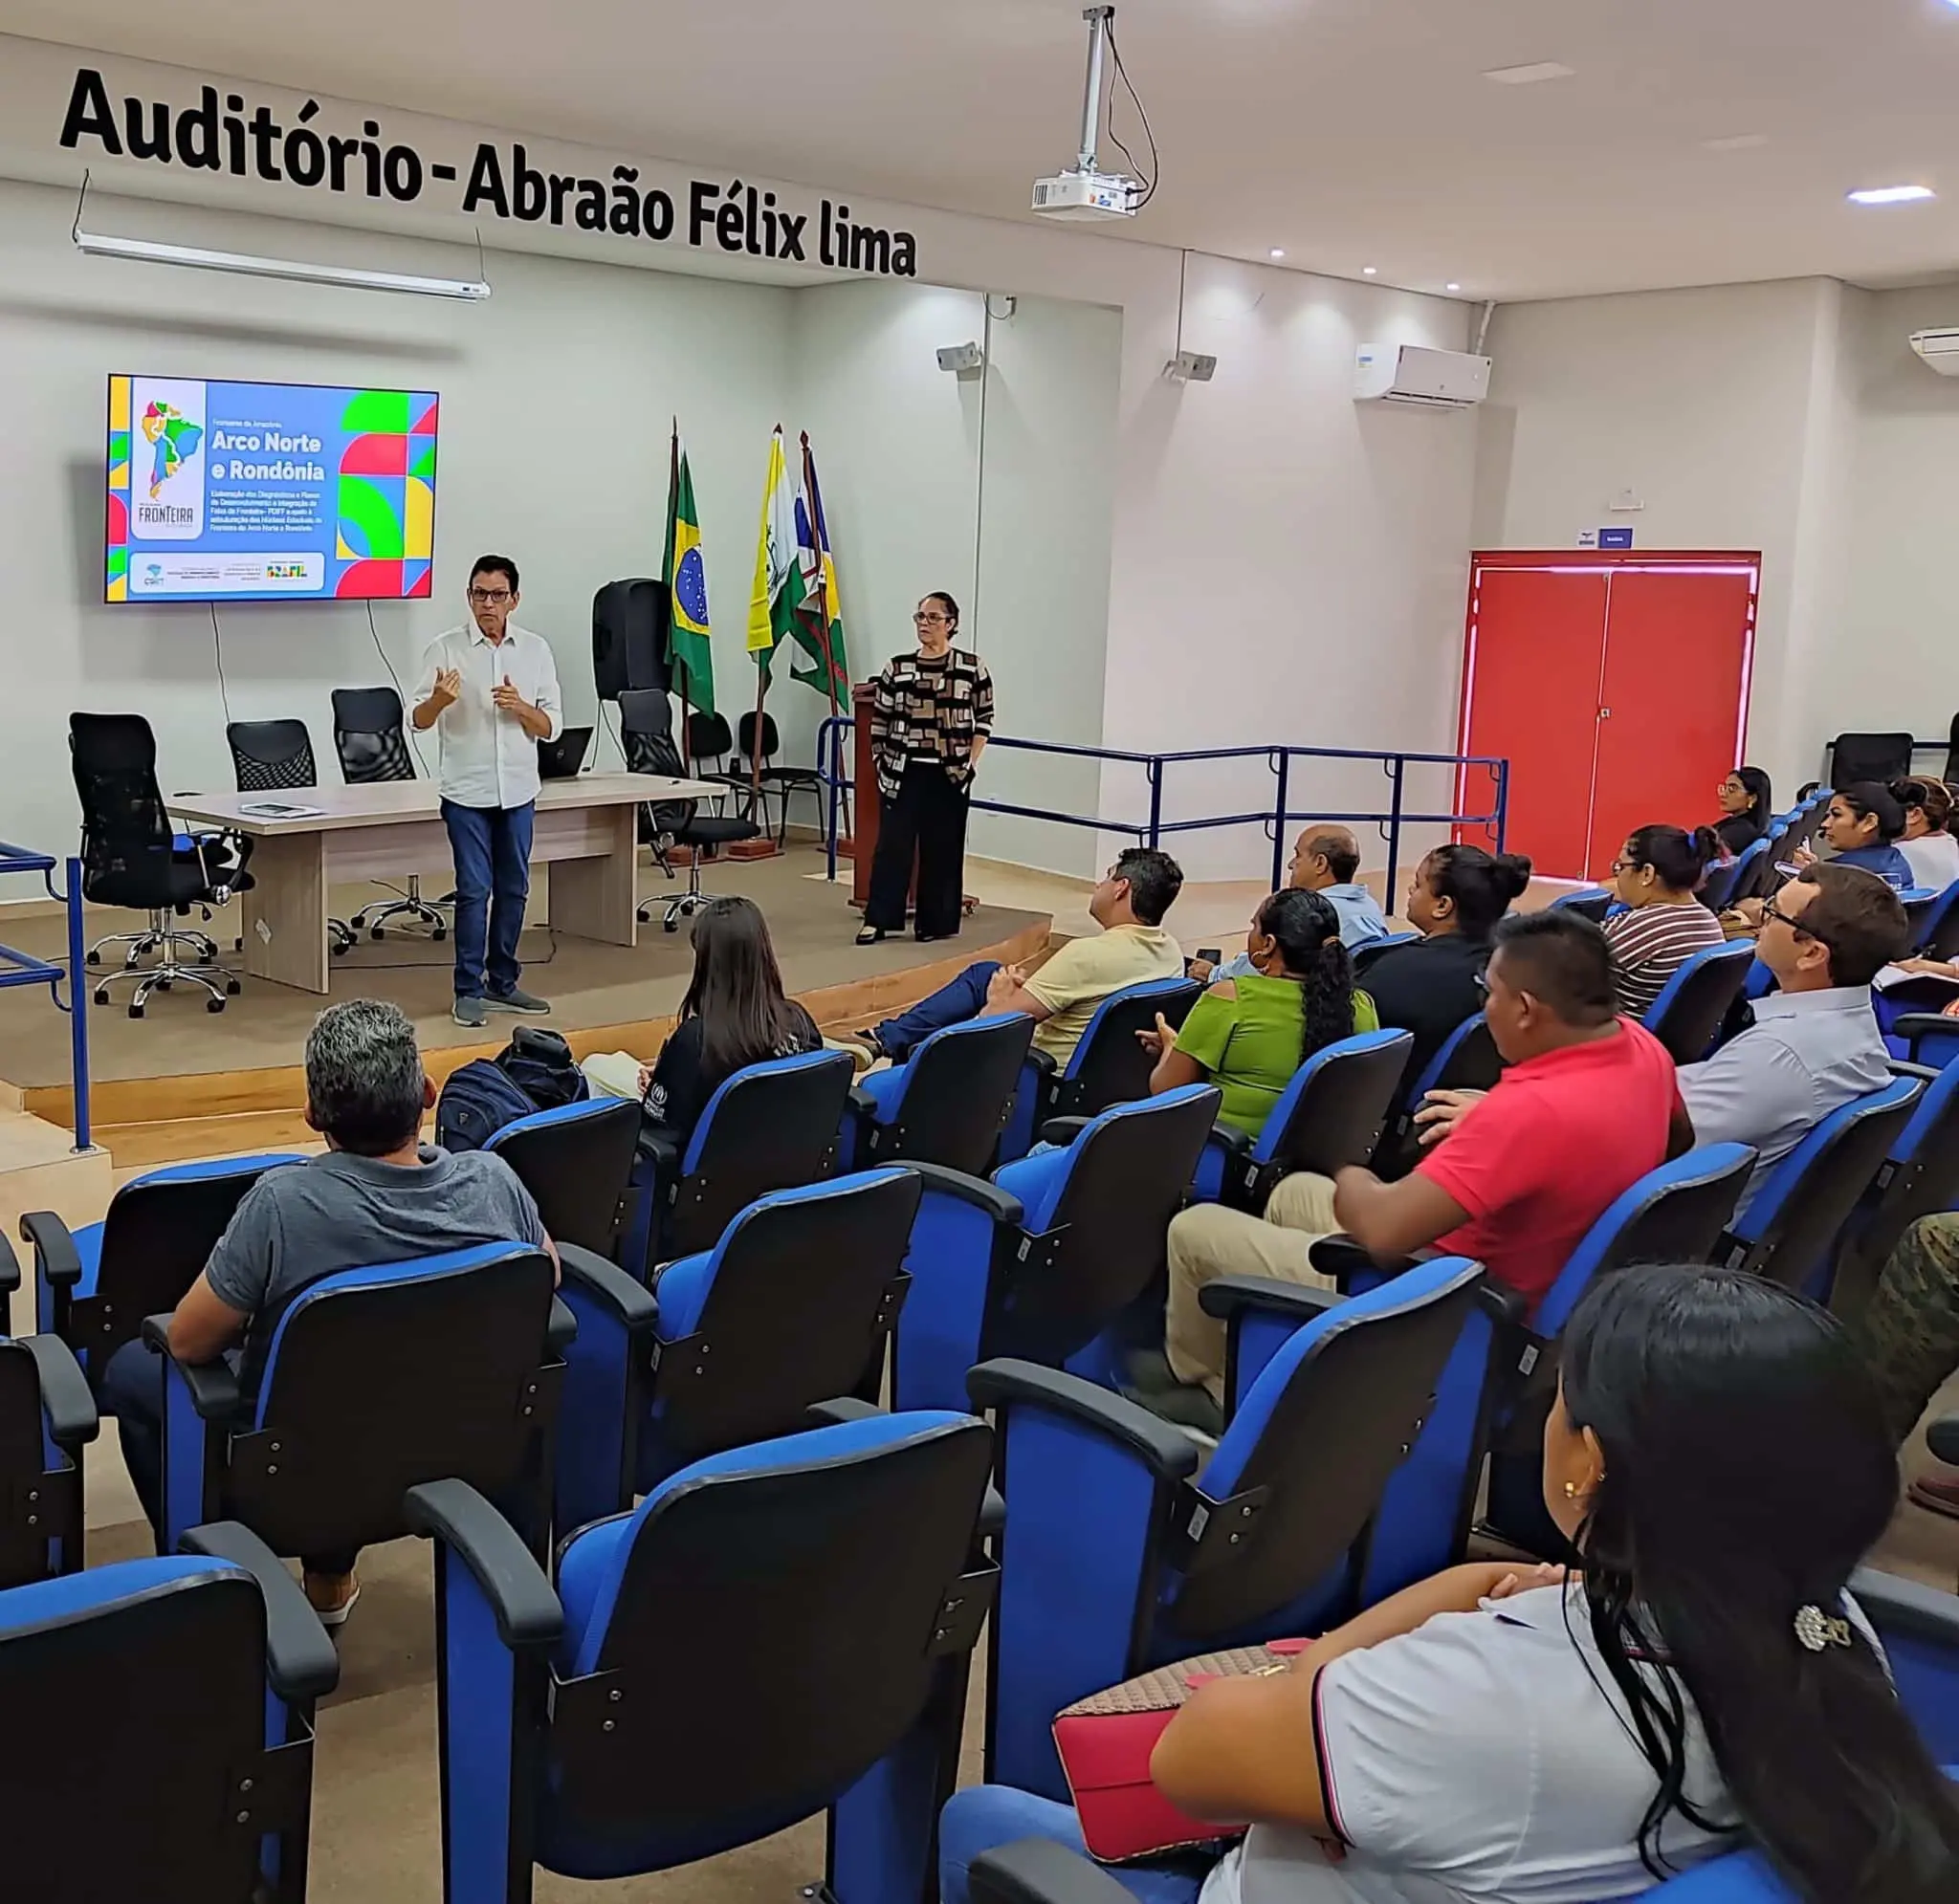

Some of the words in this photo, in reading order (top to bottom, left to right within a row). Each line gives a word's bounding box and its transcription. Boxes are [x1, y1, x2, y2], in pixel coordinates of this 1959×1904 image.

[689, 179, 807, 261] Félix
[820, 200, 917, 278] lima
[211, 429, 260, 452] Arco
[264, 431, 322, 453] Norte
[210, 463, 226, 480] e
[230, 459, 325, 482] Rondônia
[139, 505, 193, 523] FRONTEIRA
